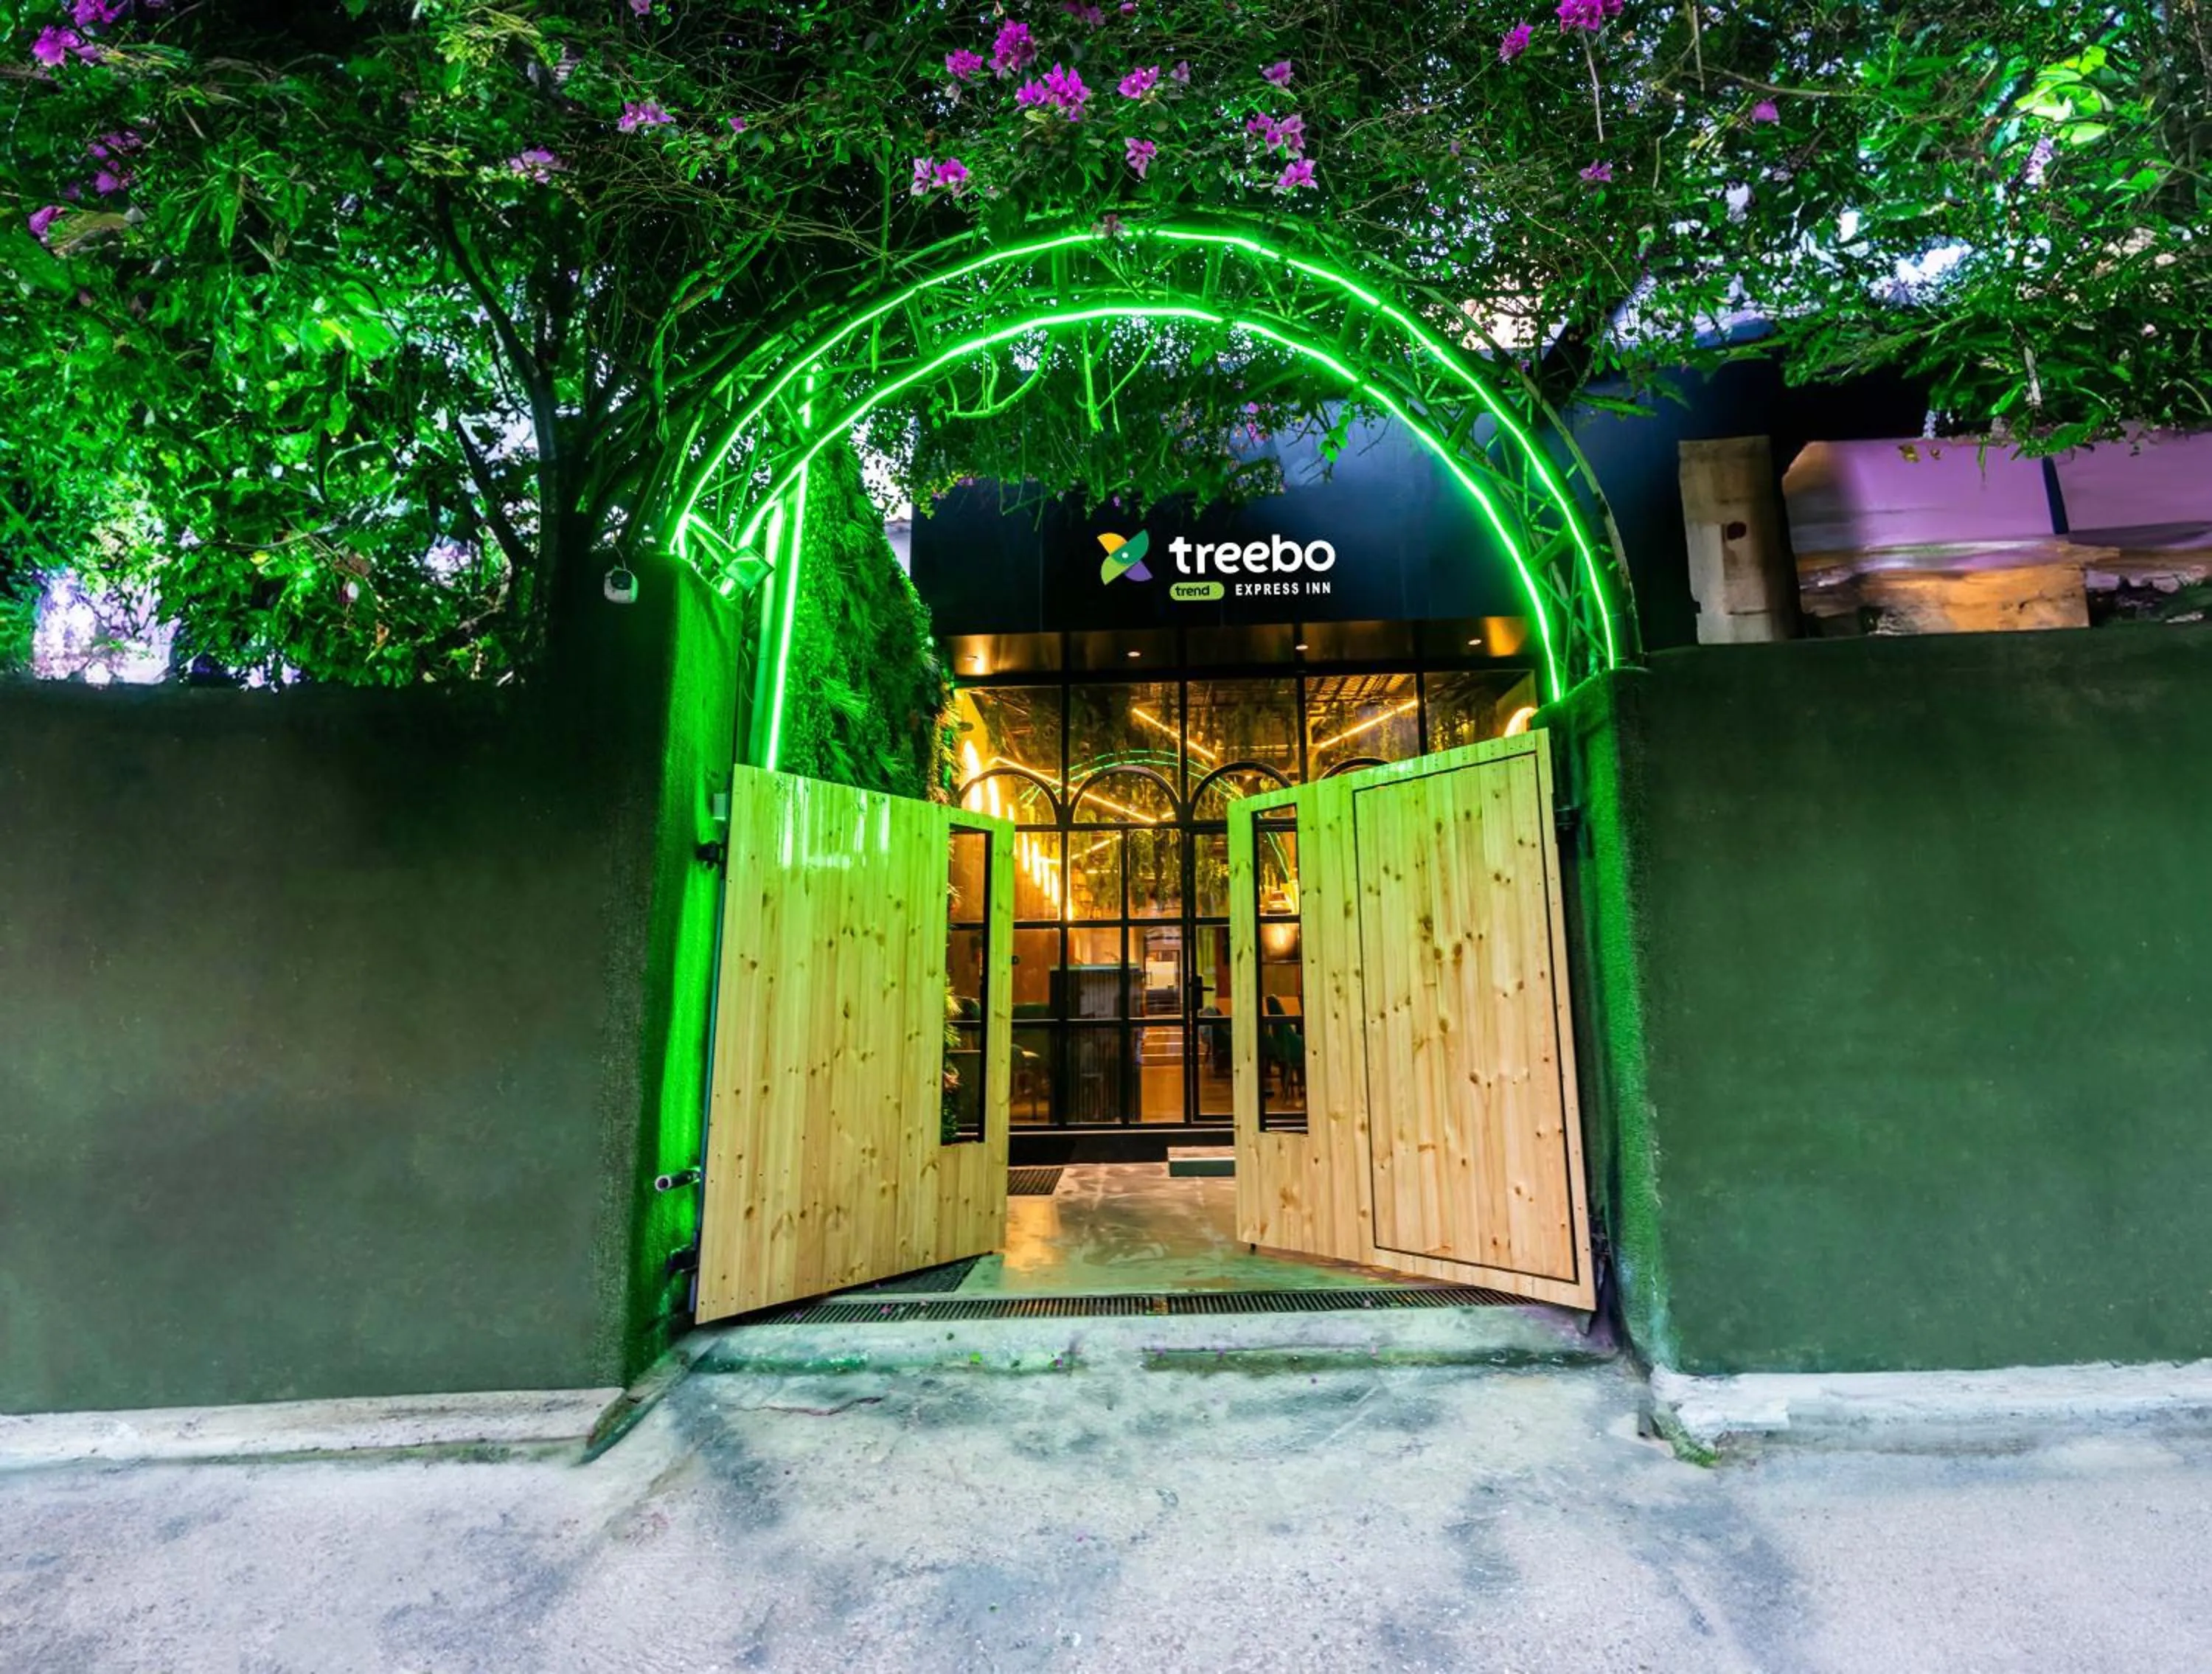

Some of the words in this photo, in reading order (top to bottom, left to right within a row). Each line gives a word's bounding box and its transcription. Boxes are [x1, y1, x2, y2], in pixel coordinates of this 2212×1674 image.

[1169, 534, 1336, 574] treebo
[1175, 585, 1210, 597] trend
[1235, 583, 1299, 596] EXPRESS
[1306, 582, 1331, 594] INN
